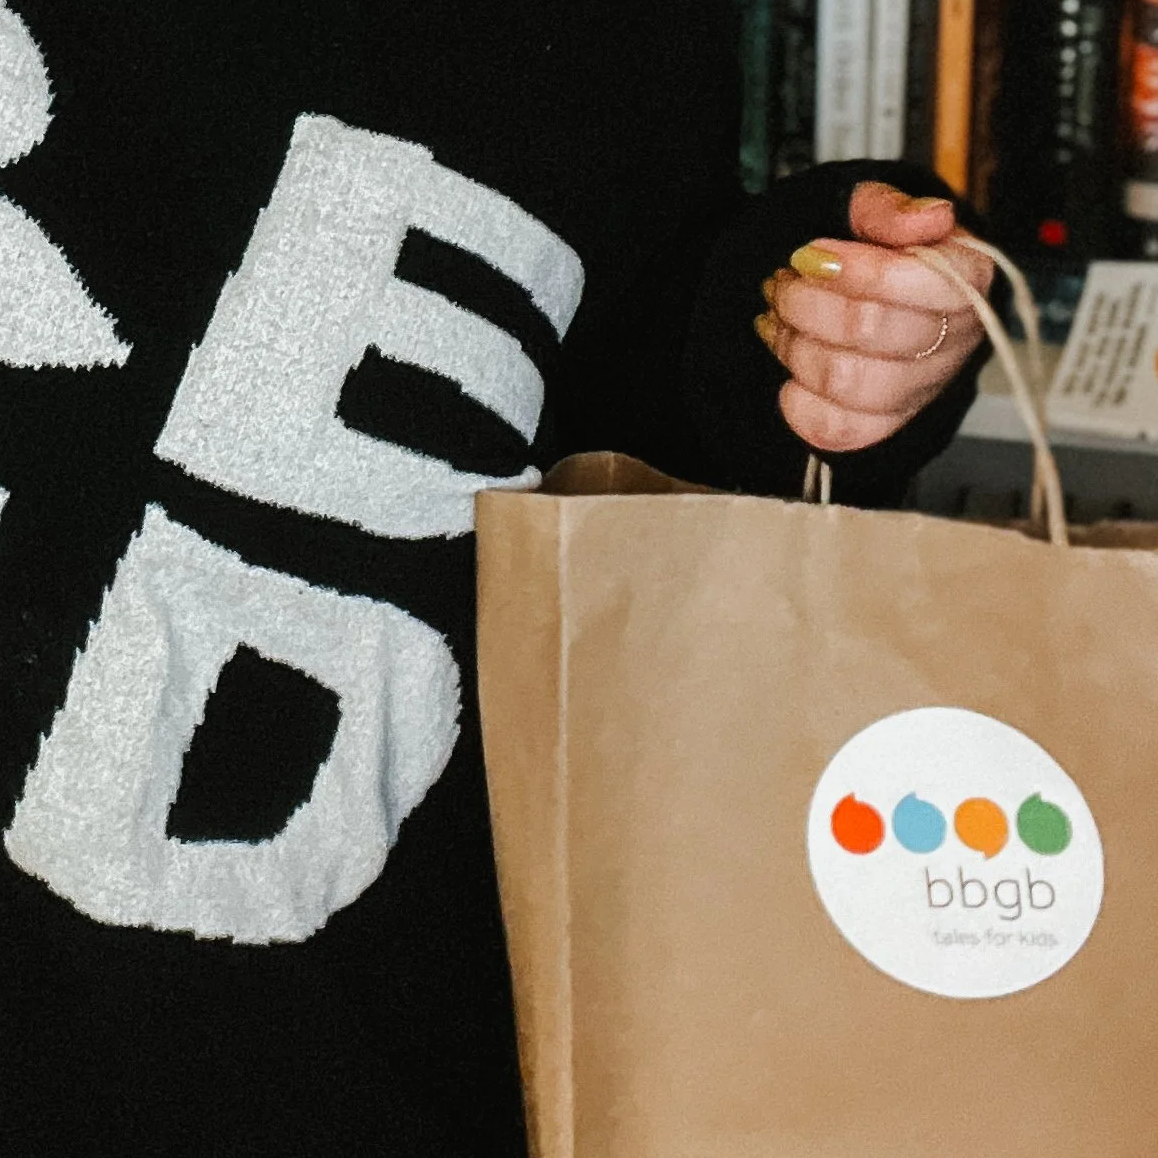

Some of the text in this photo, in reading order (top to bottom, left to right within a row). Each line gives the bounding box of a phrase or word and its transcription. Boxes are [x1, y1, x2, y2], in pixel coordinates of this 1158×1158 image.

[924, 866, 1055, 921] bbgb
[932, 928, 980, 946] tales
[985, 928, 1014, 944] for
